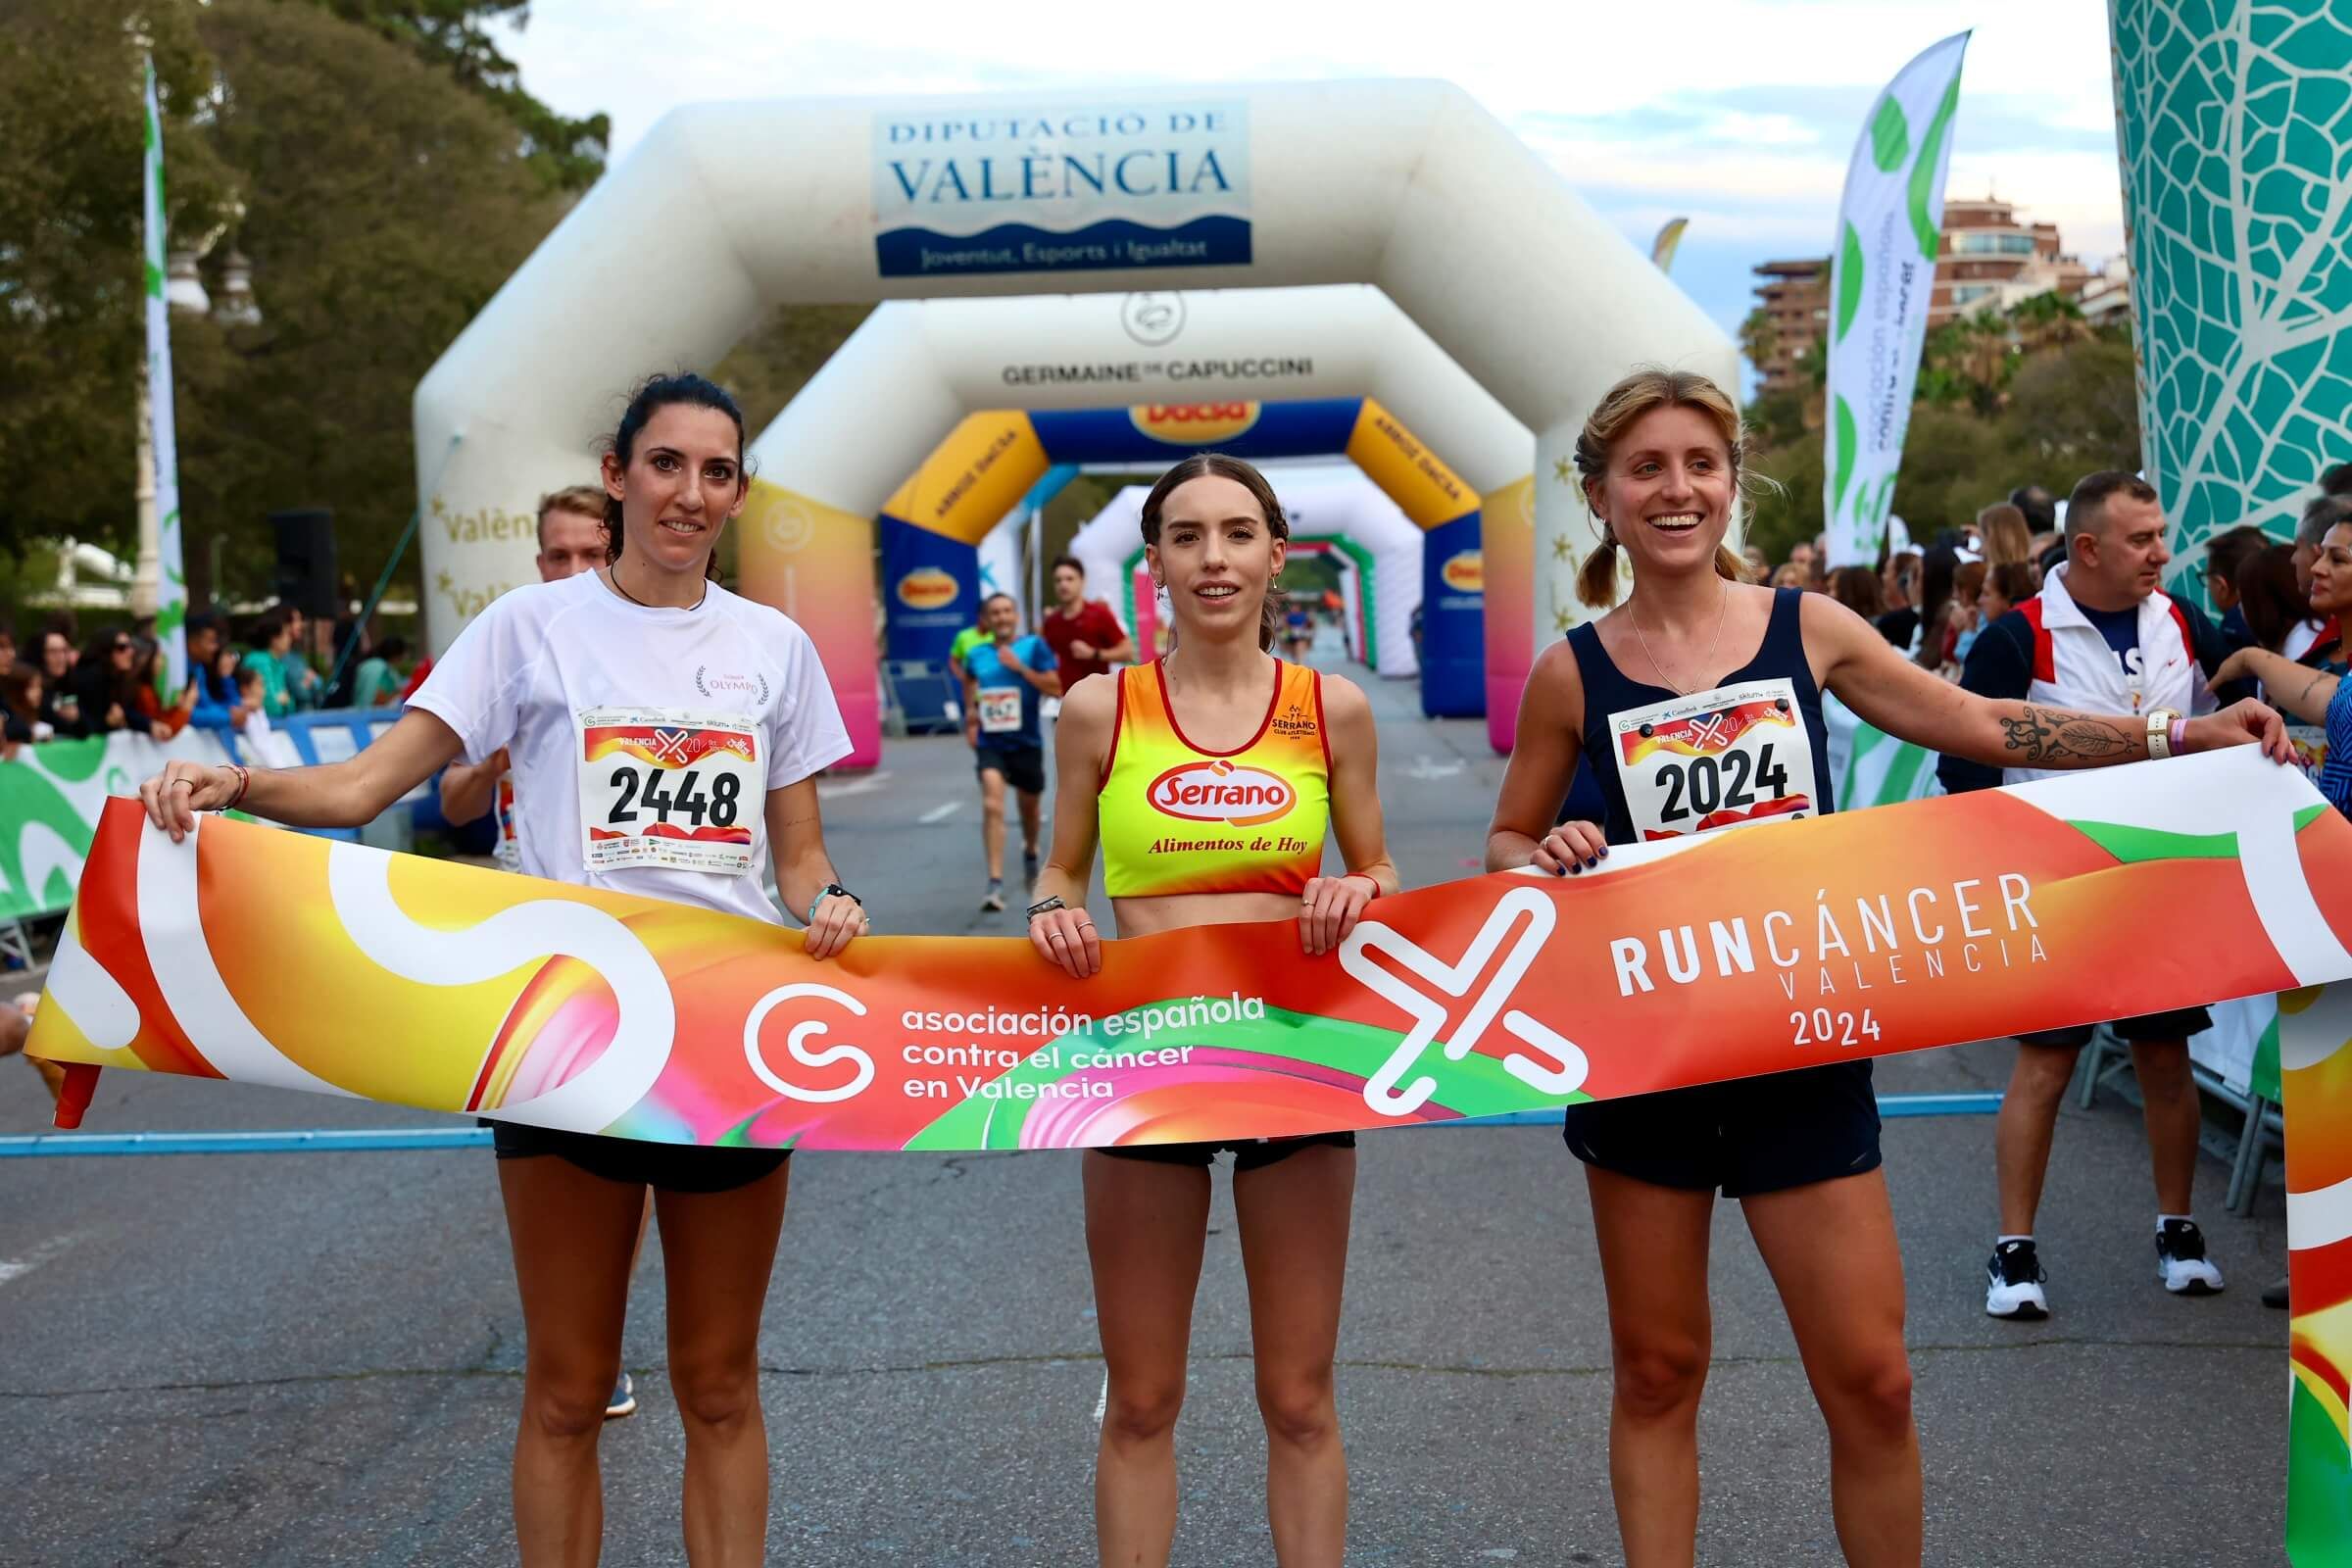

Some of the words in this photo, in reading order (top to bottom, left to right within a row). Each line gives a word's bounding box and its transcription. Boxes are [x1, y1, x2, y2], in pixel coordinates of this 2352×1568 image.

[1169, 113, 1225, 133] DE
[887, 145, 1232, 203] VALÈNCIA
[1127, 239, 1207, 263] Igualtat
[1002, 362, 1141, 386] GERMAINE
[1166, 357, 1313, 380] CAPUCCINI
[445, 507, 535, 543] Valèn
[1272, 718, 1316, 730] SERRANO
[608, 766, 741, 828] 2448
[1159, 776, 1286, 808] Serrano
[1655, 743, 1788, 824] 2024
[1149, 837, 1245, 855] Alimentos
[1250, 836, 1272, 853] de
[1275, 836, 1308, 856] Hoy
[1779, 934, 2048, 1002] VALENCIA
[901, 1004, 1093, 1036] asociación
[1103, 991, 1266, 1040] española
[1789, 1006, 1882, 1048] 2024
[902, 1041, 1020, 1069] contra
[1029, 1046, 1060, 1069] el
[1069, 1042, 1195, 1070] cáncer
[903, 1076, 949, 1099] en
[956, 1075, 1114, 1101] Valencia
